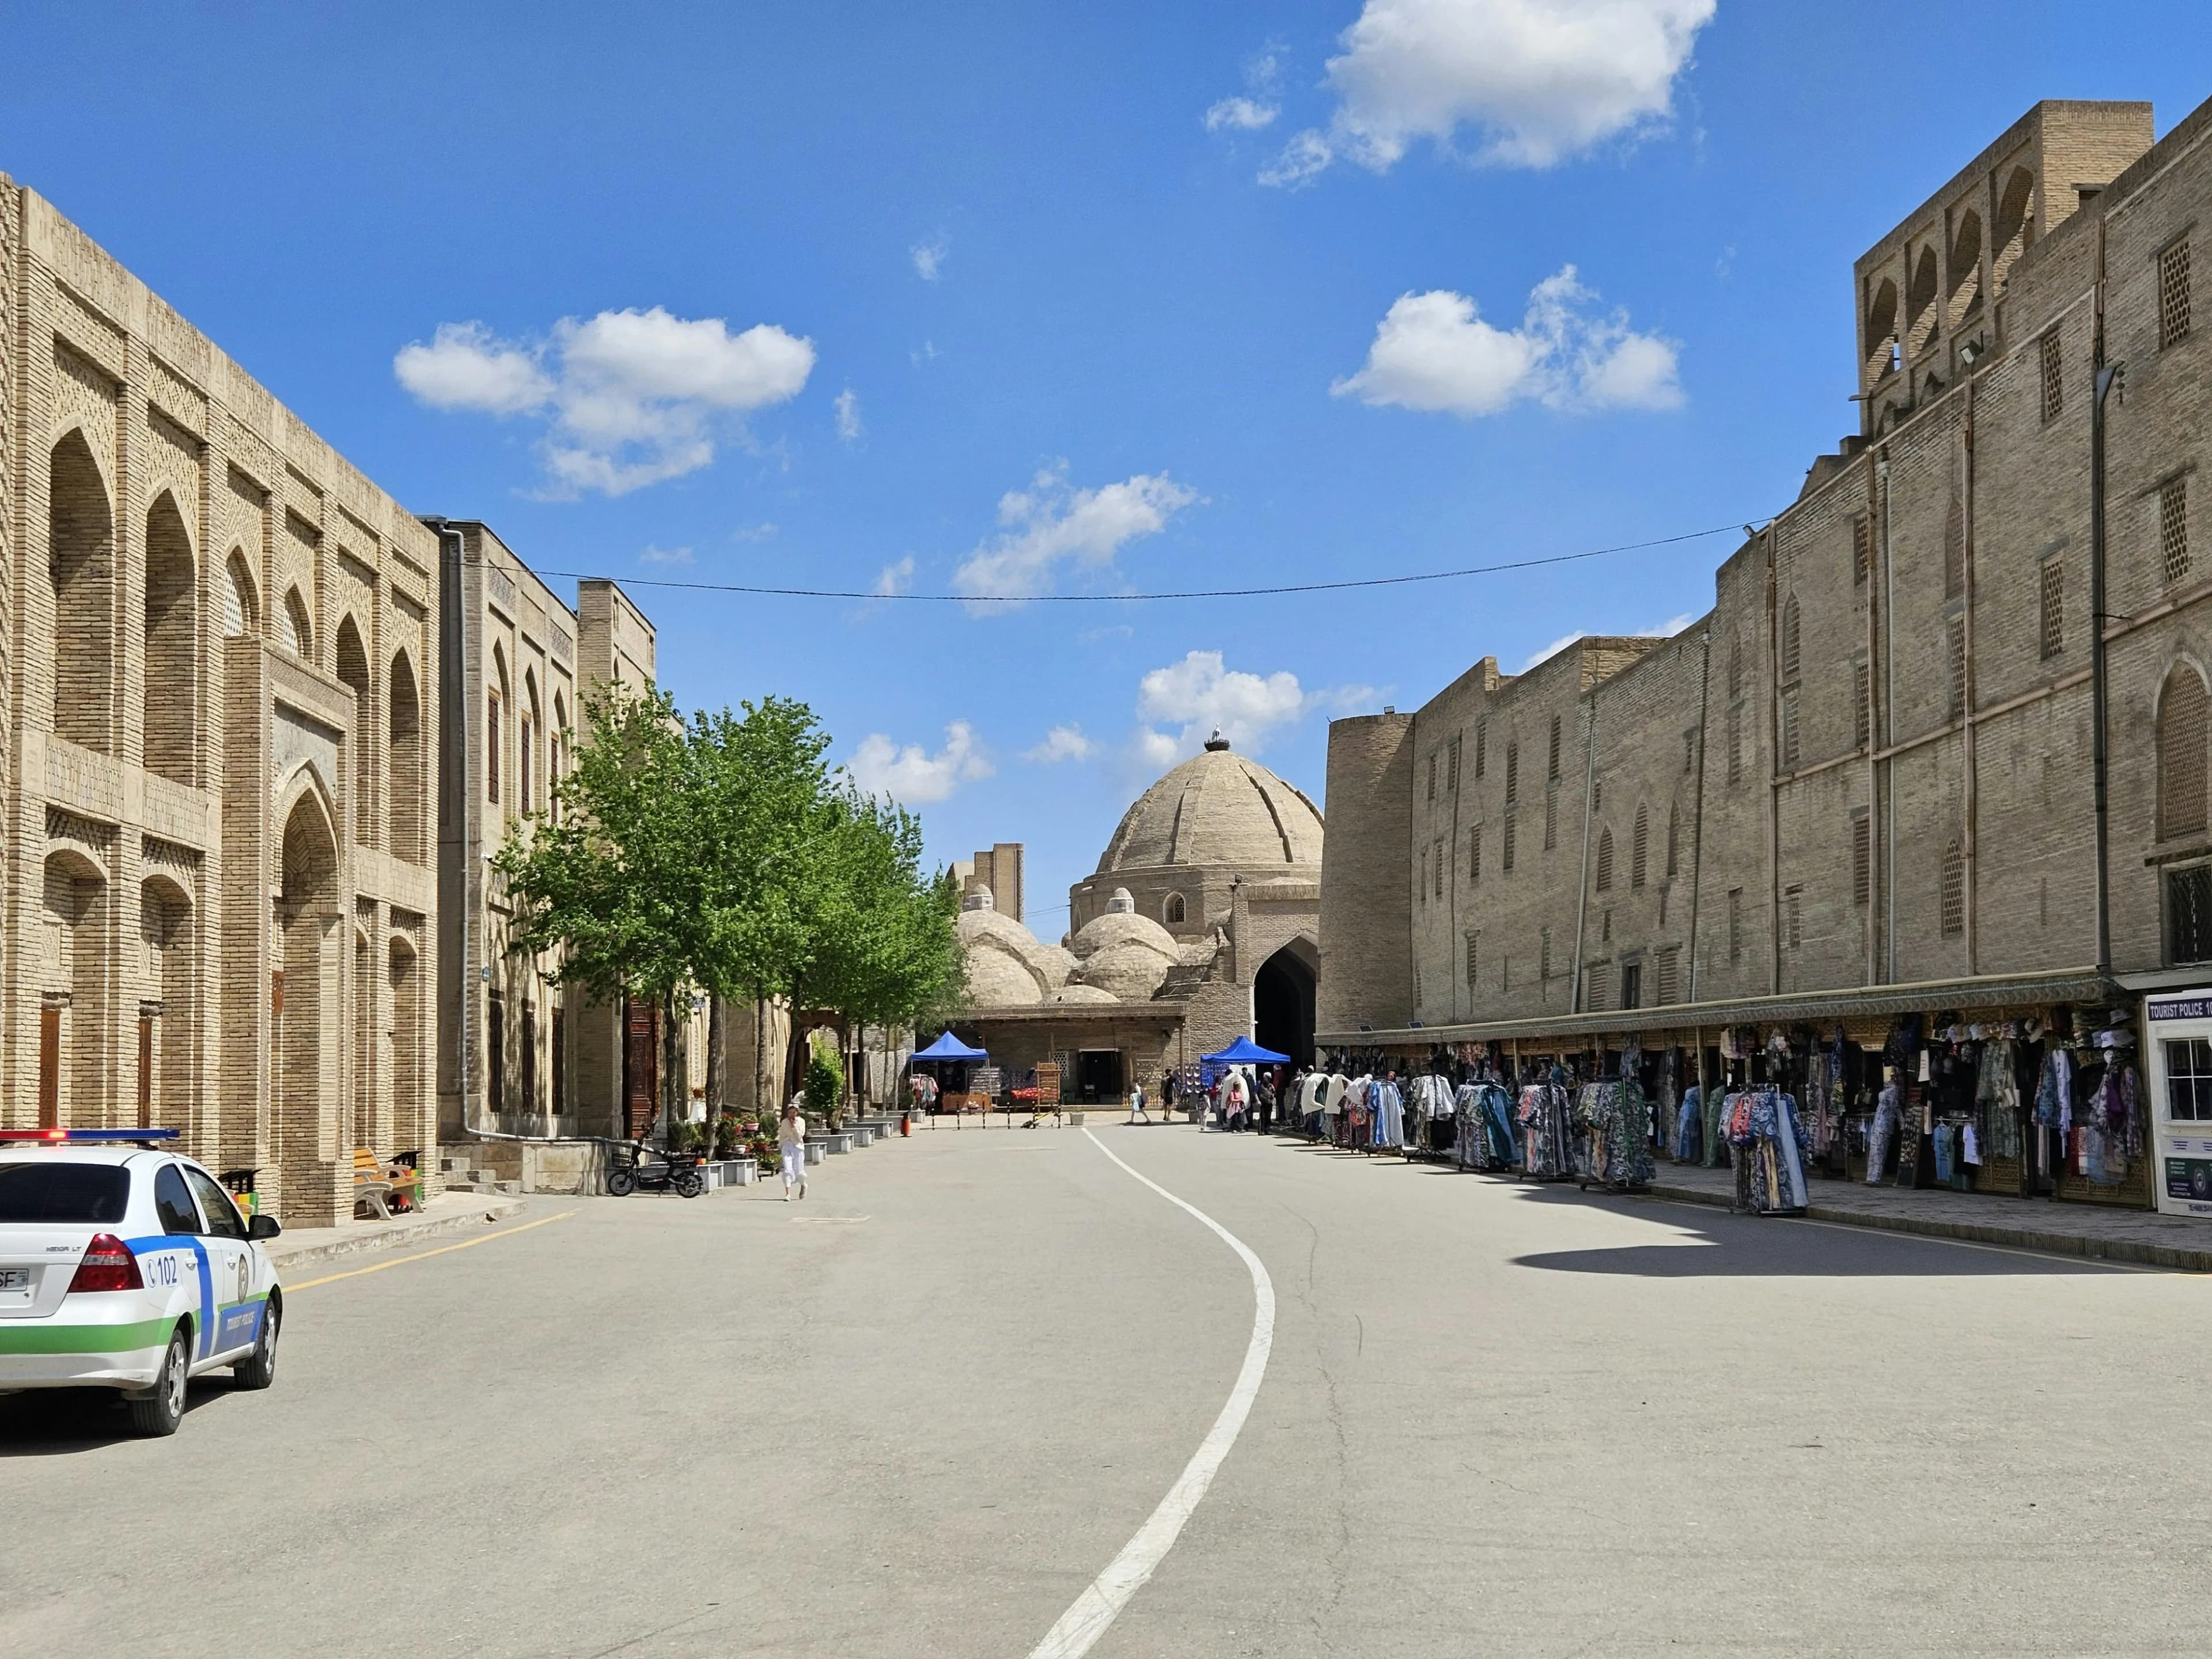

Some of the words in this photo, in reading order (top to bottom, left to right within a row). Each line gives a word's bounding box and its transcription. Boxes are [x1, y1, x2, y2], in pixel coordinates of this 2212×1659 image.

[2150, 1004, 2177, 1018] TOURIST
[2179, 1002, 2203, 1017] POLICE
[158, 1256, 177, 1286] 102
